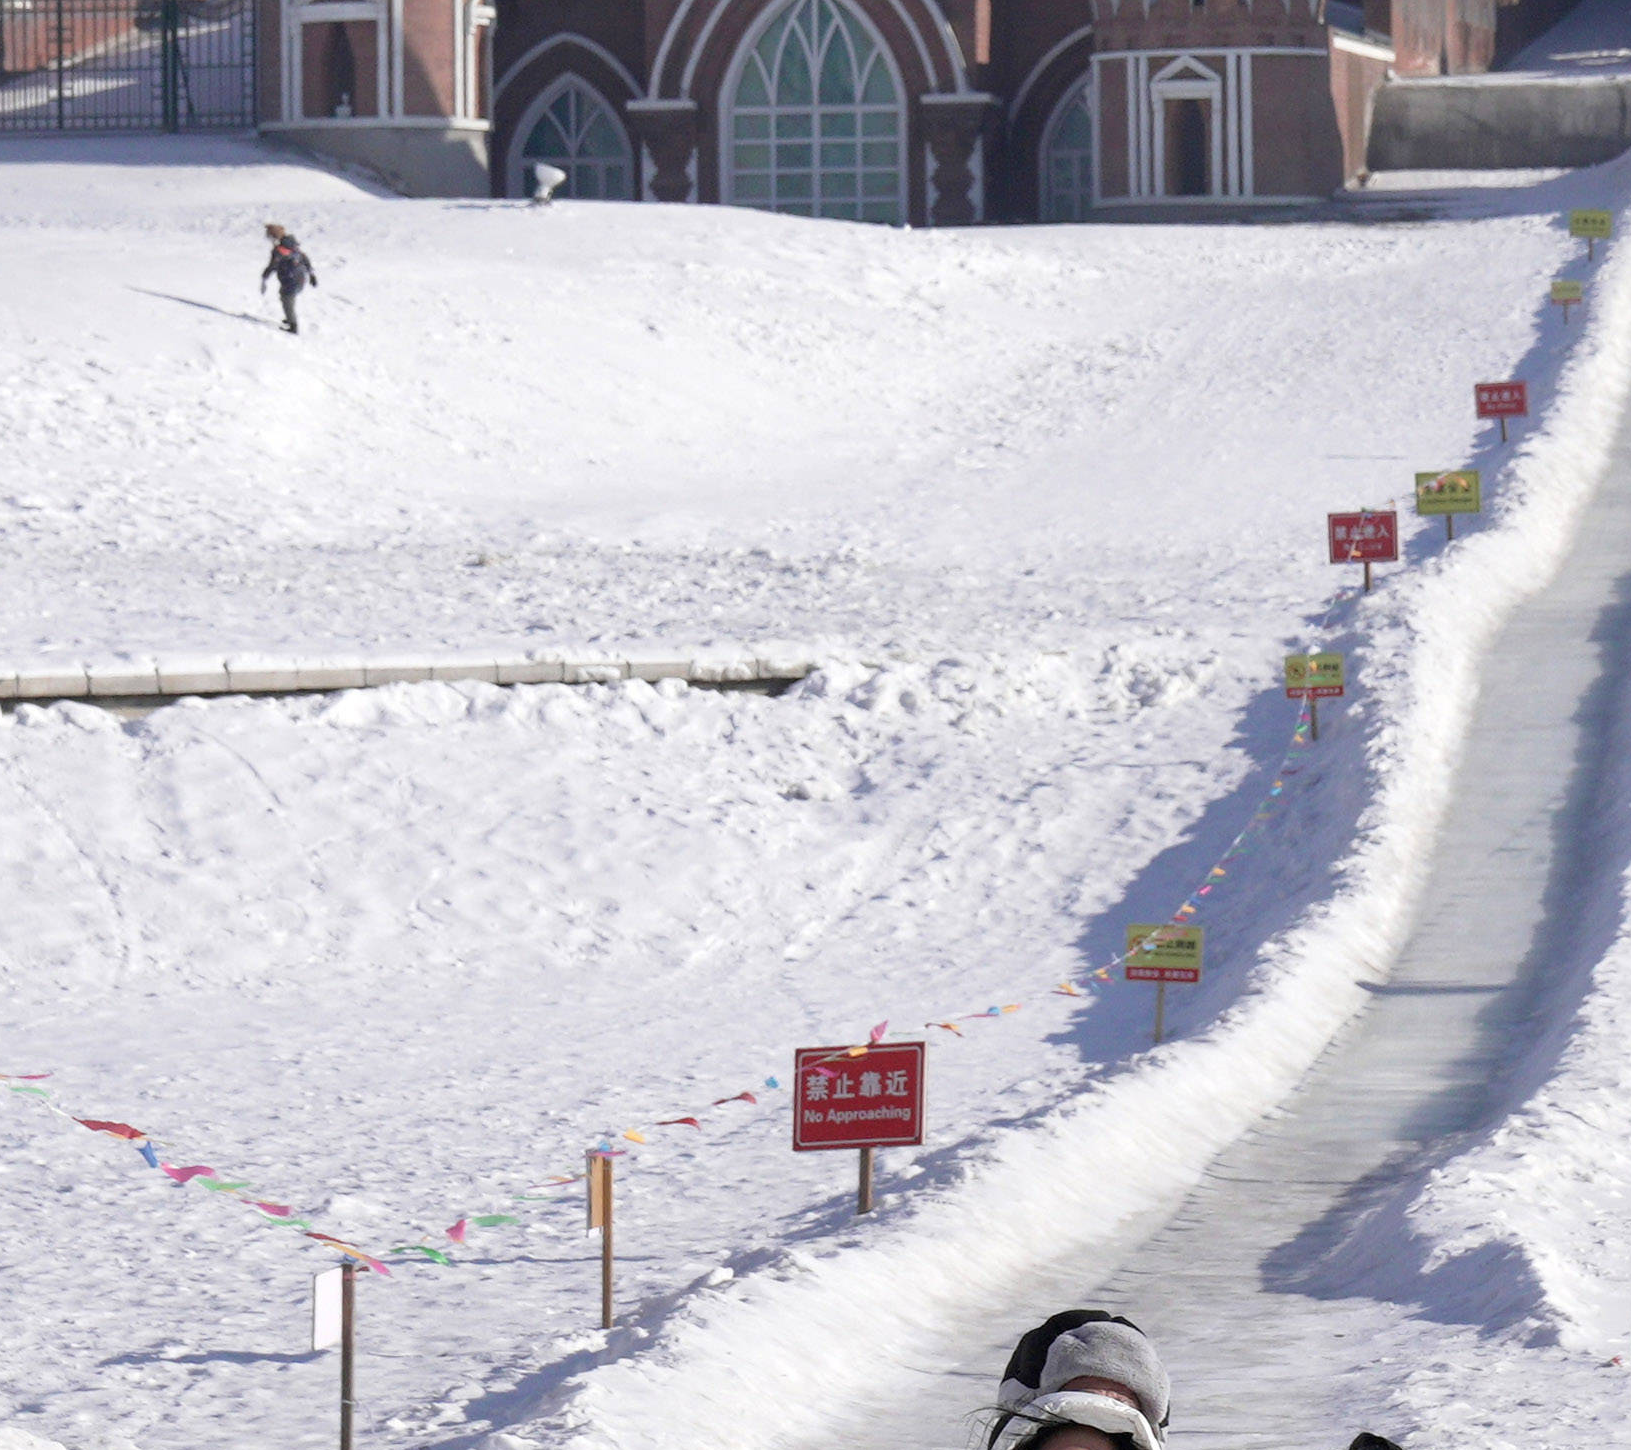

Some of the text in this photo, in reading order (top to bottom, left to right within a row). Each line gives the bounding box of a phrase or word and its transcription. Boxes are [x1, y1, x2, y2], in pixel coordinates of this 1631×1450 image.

[806, 1070, 908, 1101] 禁止靠近
[804, 1104, 911, 1124] No Approaching
